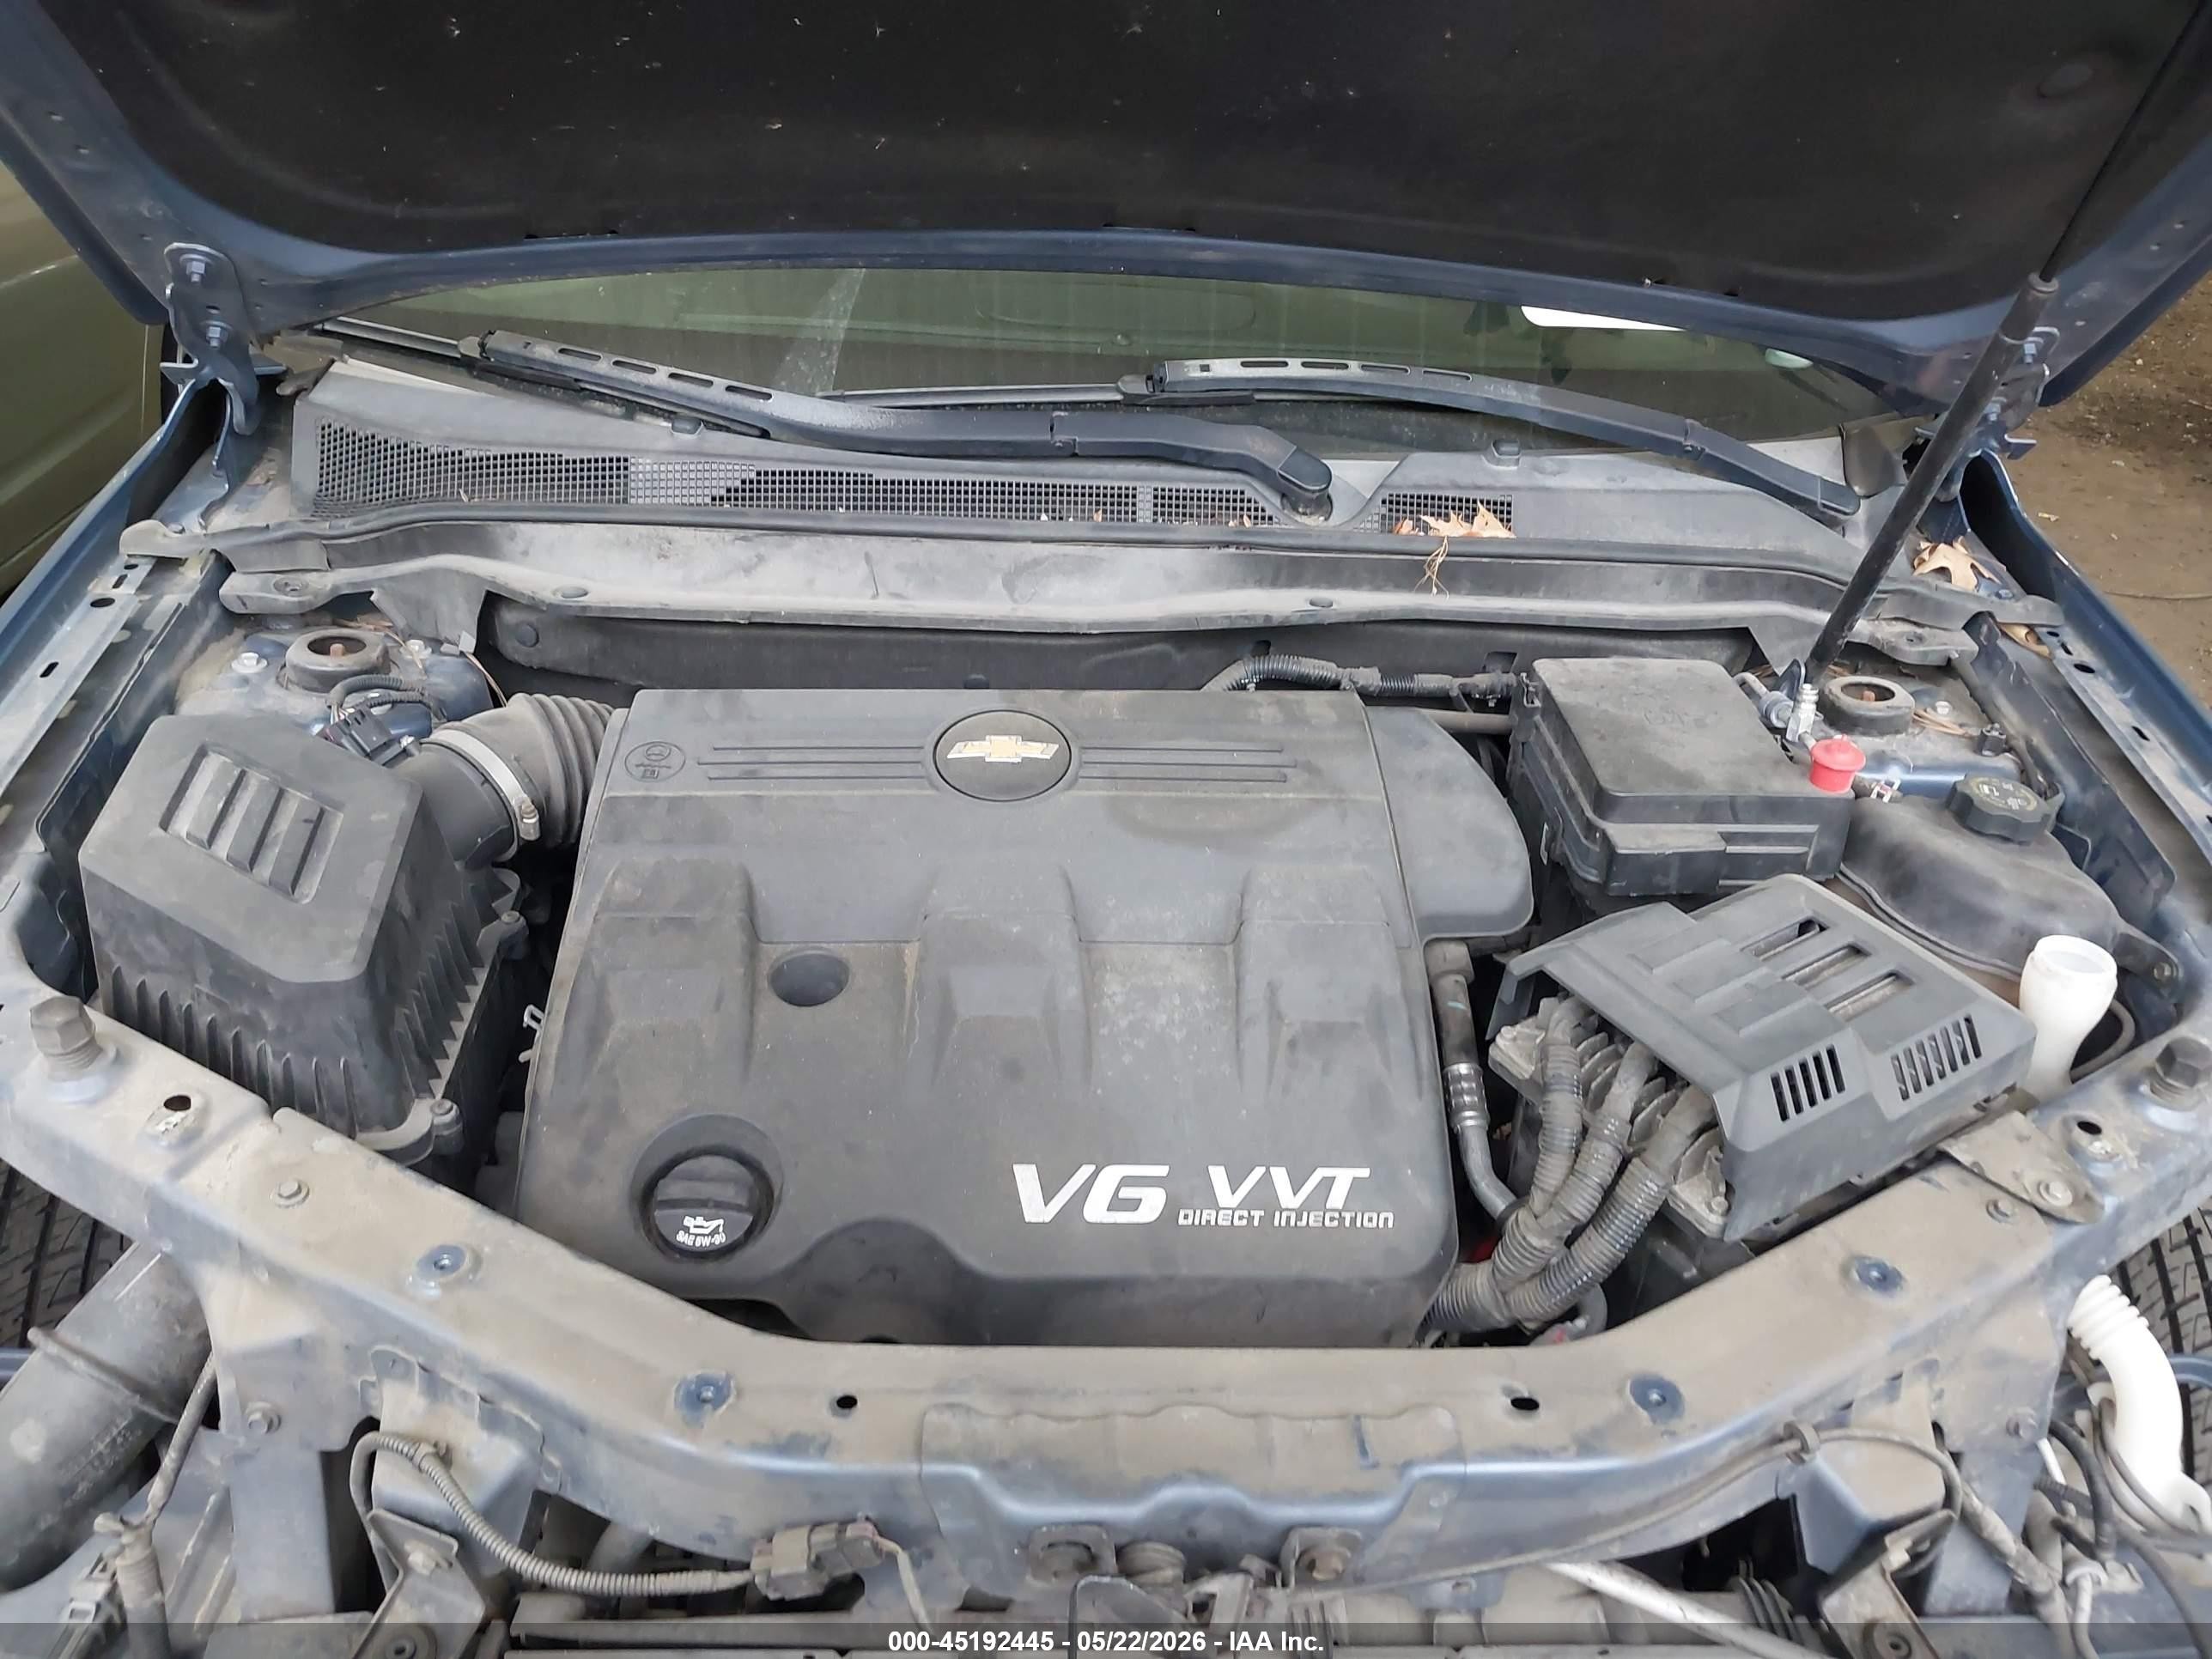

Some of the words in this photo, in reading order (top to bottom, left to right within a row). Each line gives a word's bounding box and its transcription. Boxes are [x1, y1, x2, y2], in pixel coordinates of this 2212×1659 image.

[1012, 1164, 1170, 1224] V6
[1207, 1164, 1370, 1208] VVT
[1178, 1209, 1265, 1227] DIRECT
[1273, 1210, 1395, 1229] INJECTION
[677, 1231, 696, 1246] SAE
